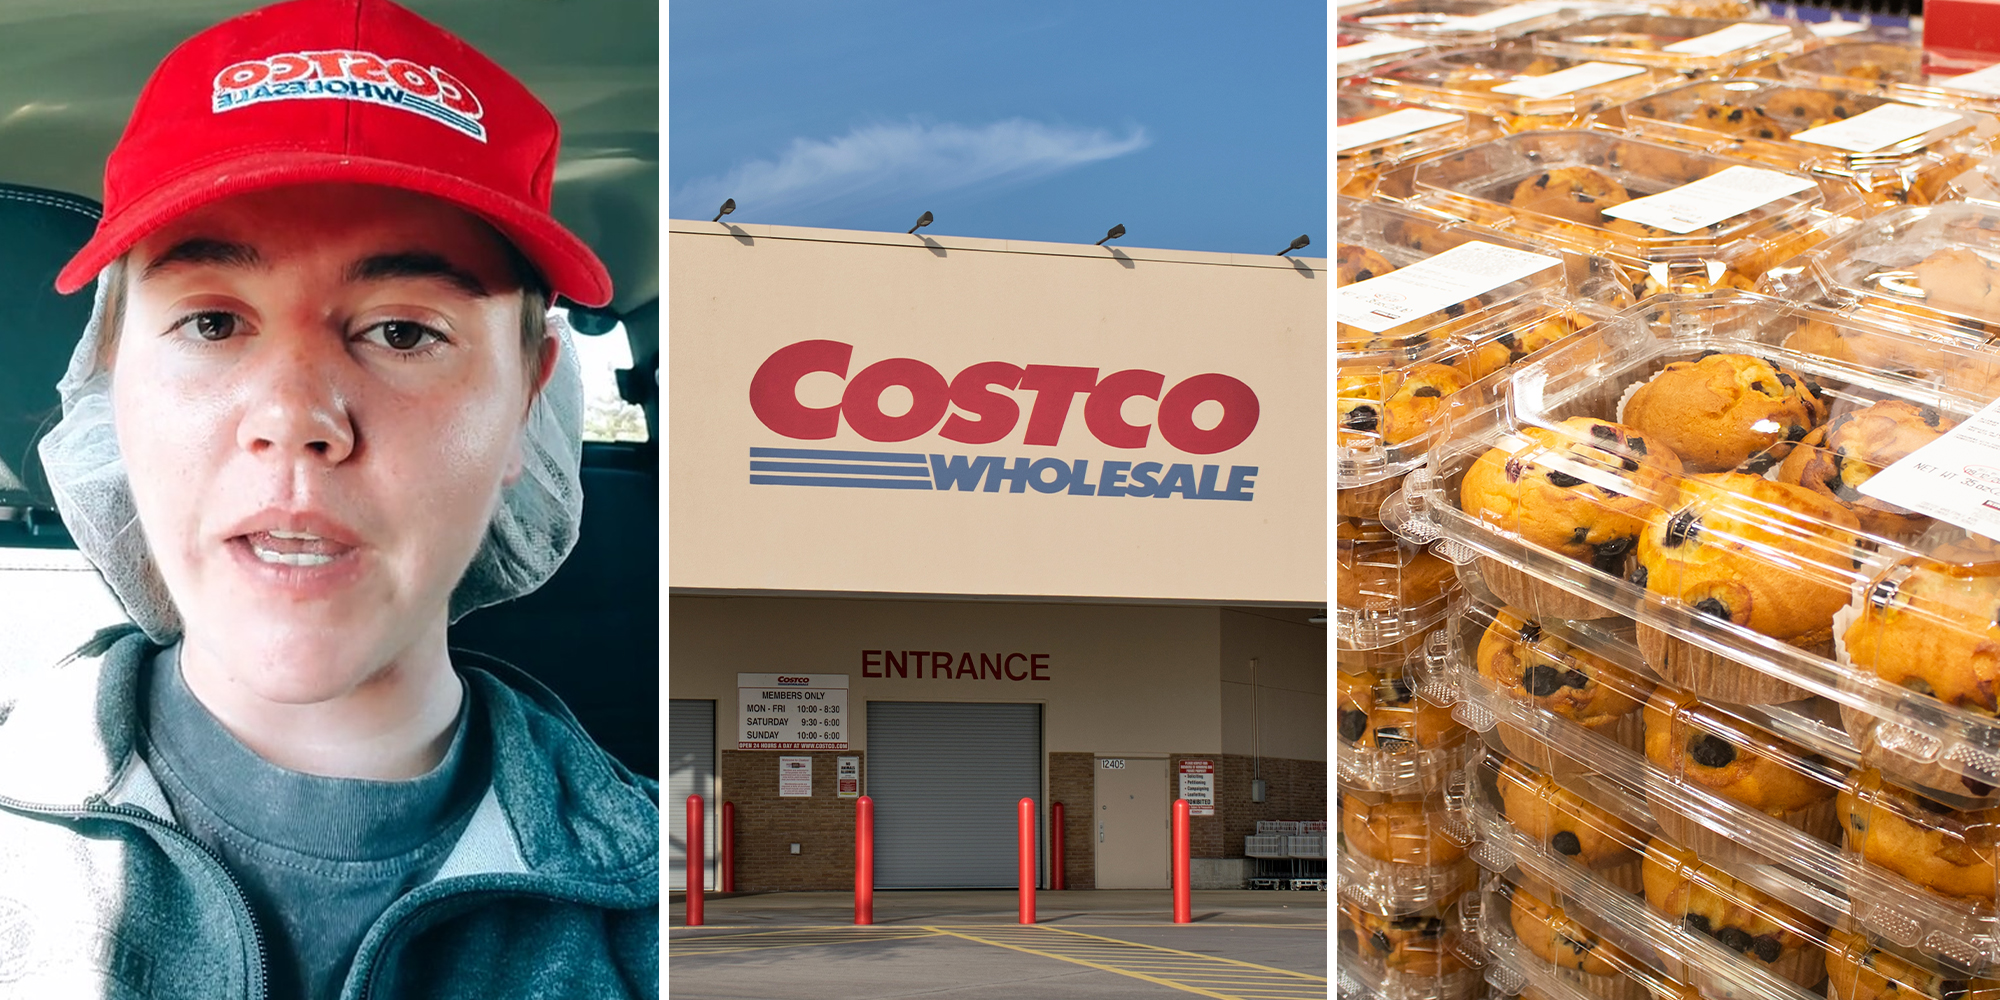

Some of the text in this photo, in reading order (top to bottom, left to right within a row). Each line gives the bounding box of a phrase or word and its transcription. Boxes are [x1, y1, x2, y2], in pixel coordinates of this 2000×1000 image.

[749, 339, 1260, 455] COSTCO
[1913, 462, 1938, 474] NET
[1939, 471, 1958, 480] WT
[928, 453, 1259, 502] WHOLESALE
[862, 650, 1051, 681] ENTRANCE
[762, 691, 826, 700] MEMBERS ONLY
[746, 704, 766, 713] MON
[772, 704, 786, 713] FRI
[797, 705, 818, 713] 10:00
[824, 705, 840, 713] 8:30
[746, 717, 789, 726] SATURDAY
[801, 718, 818, 727] 9:30
[824, 718, 840, 727] 6:00
[746, 730, 779, 739] SUNDAY
[797, 731, 818, 740] 10:00
[824, 731, 840, 740] 6:00
[1102, 760, 1124, 769] 12405
